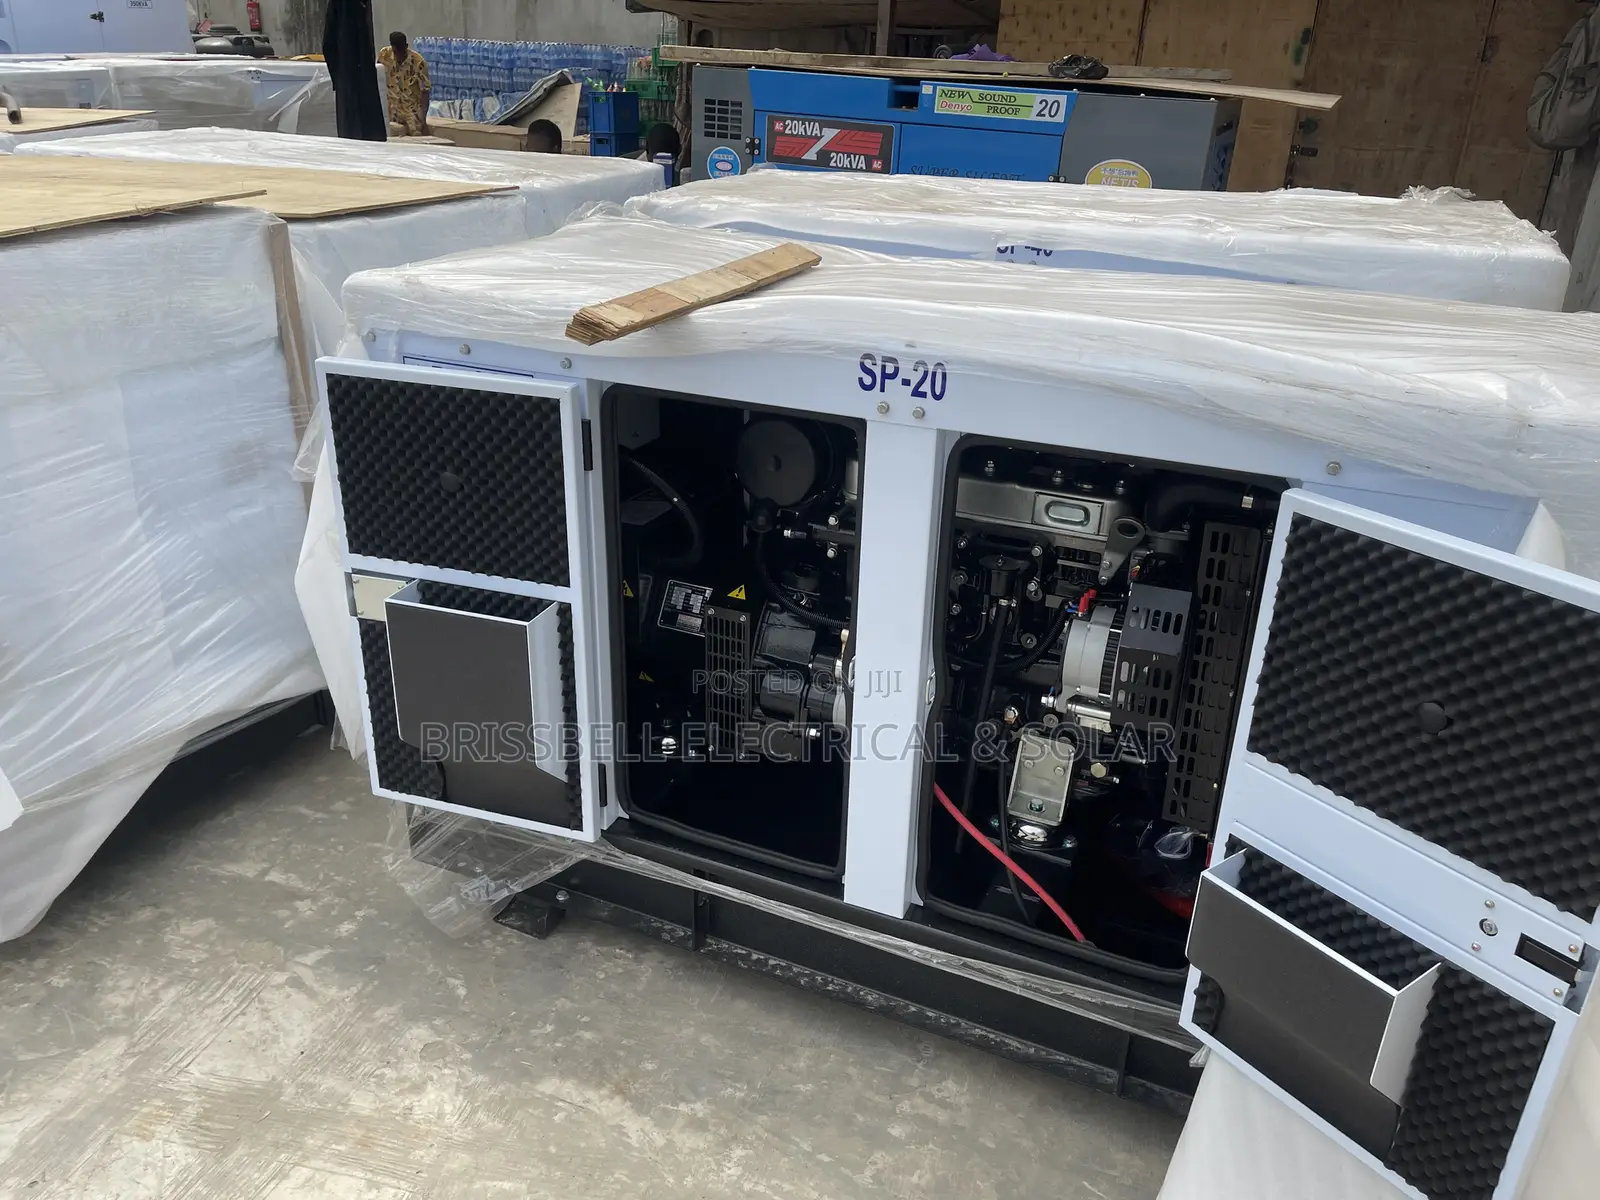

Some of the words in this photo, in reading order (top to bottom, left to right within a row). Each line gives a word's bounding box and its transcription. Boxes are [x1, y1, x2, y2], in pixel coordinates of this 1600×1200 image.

[939, 89, 968, 99] NEW
[978, 92, 1017, 104] SOUND
[939, 100, 973, 112] Denyo
[986, 105, 1021, 116] PROOF
[1036, 98, 1061, 118] 20
[785, 120, 821, 136] 20kVA
[829, 152, 867, 170] 20kVA
[872, 161, 882, 169] AC
[858, 353, 947, 401] SP-20
